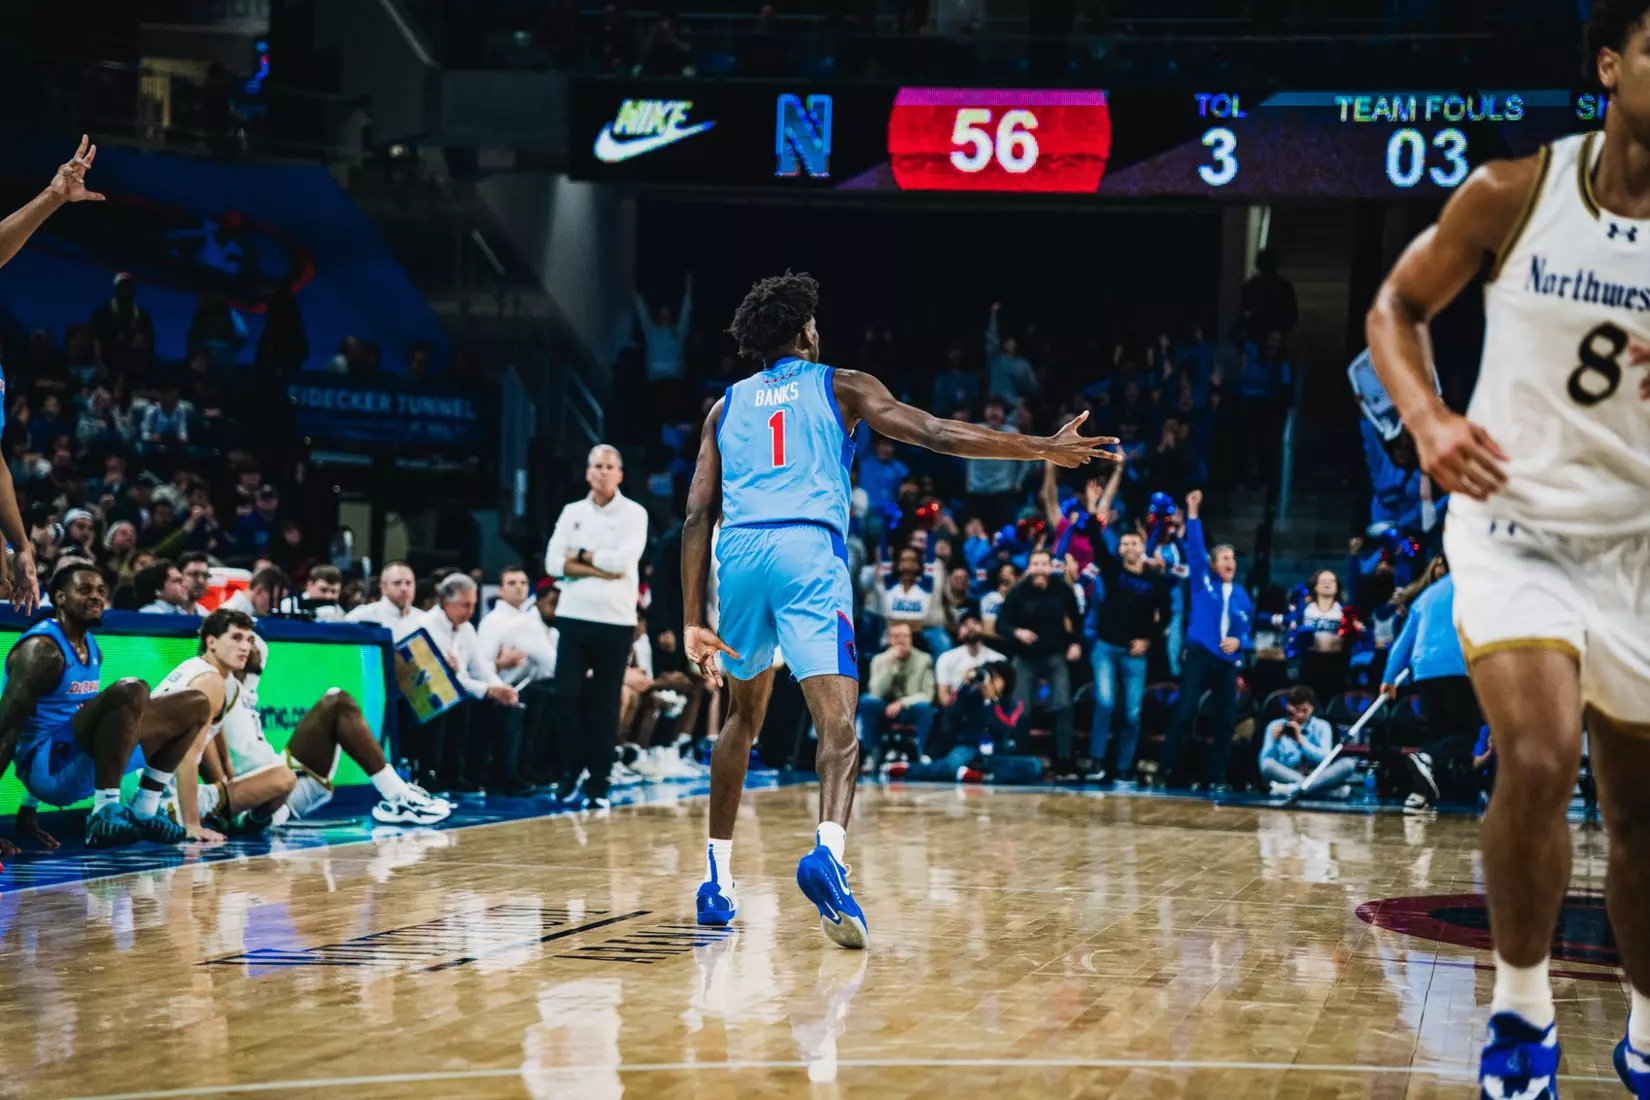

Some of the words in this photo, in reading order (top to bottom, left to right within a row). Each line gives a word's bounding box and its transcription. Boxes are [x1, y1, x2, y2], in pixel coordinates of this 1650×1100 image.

[613, 98, 694, 135] NIKE
[775, 93, 833, 177] N
[1194, 92, 1248, 119] TOL
[1334, 95, 1417, 122] TEAM
[1425, 93, 1525, 122] FOULS
[950, 108, 1039, 174] 56
[1198, 127, 1239, 188] 3
[1386, 127, 1469, 188] 03
[755, 381, 799, 407] BANKS
[1566, 321, 1630, 408] 8
[768, 409, 786, 468] 1
